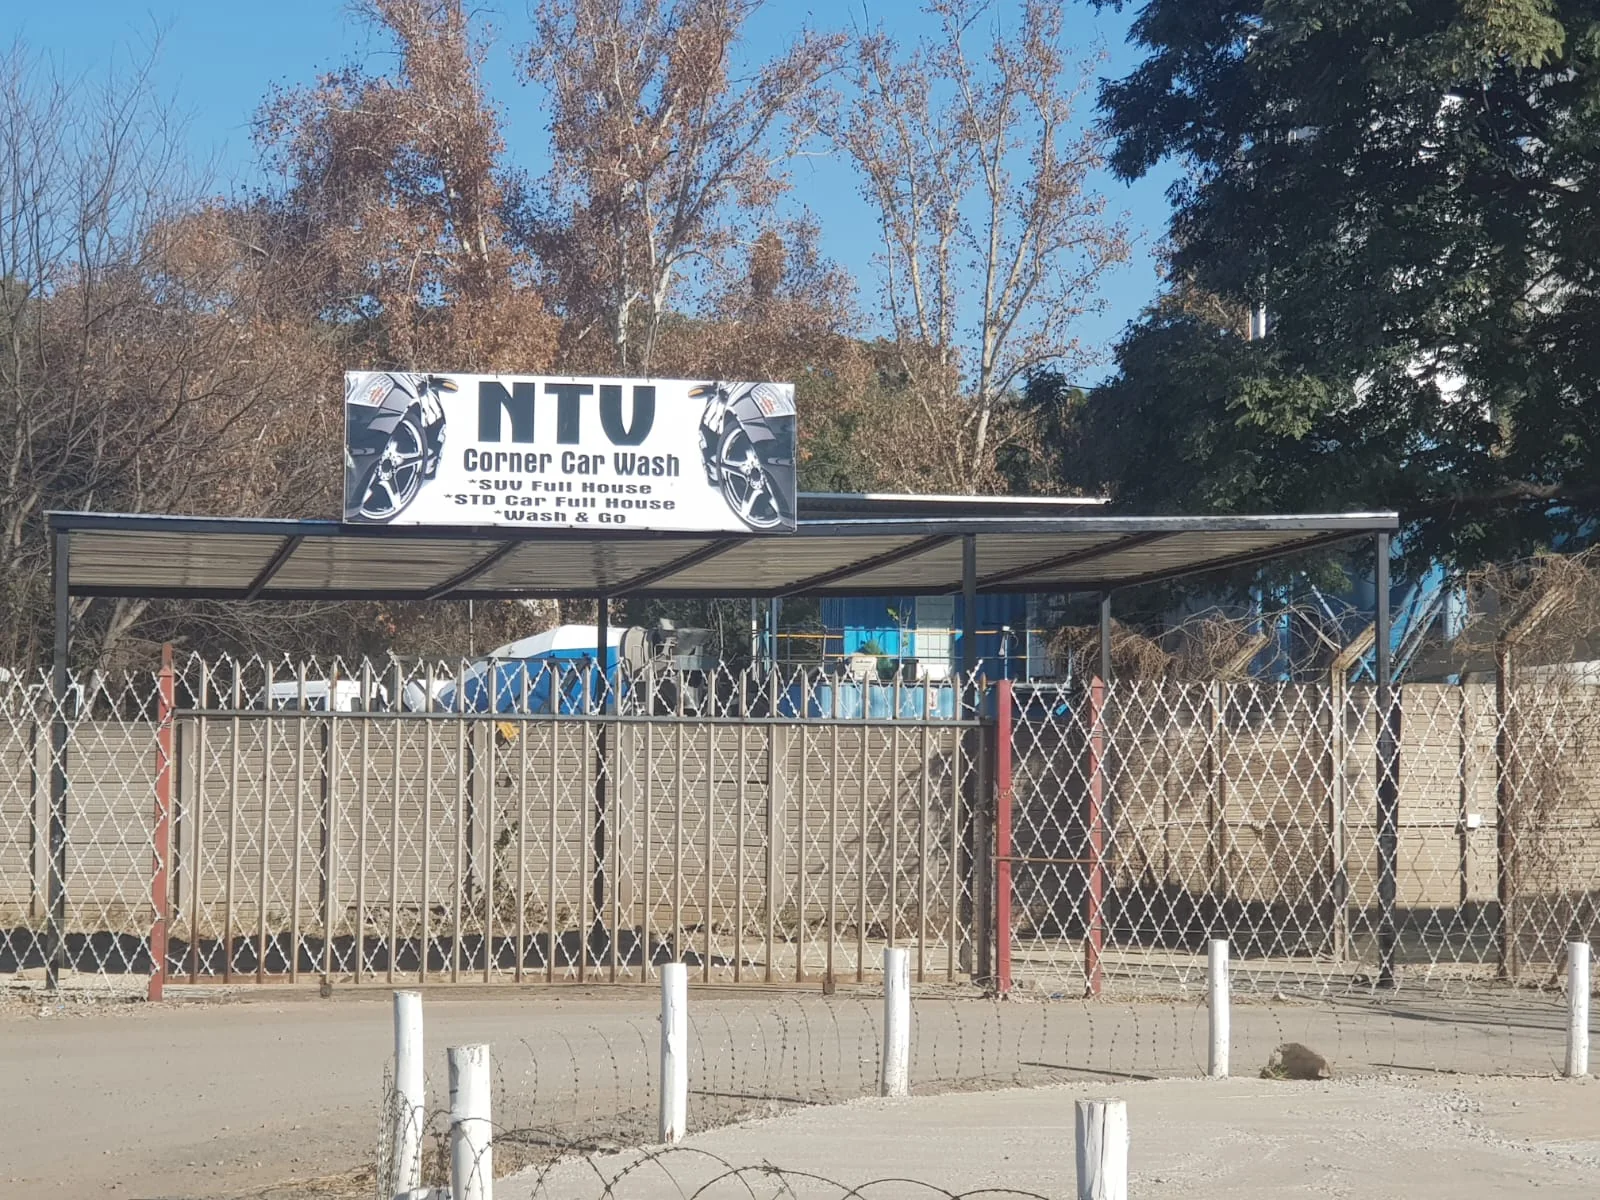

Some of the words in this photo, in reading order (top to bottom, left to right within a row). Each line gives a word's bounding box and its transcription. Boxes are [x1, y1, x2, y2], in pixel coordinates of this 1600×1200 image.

[463, 448, 553, 474] Corner
[561, 450, 606, 476] Car
[613, 452, 680, 477] Wash
[531, 480, 572, 493] Full
[581, 482, 652, 495] House
[505, 495, 547, 507] Car
[555, 496, 596, 509] Full
[605, 497, 676, 511] House
[575, 512, 589, 523] &
[598, 512, 626, 525] Go
